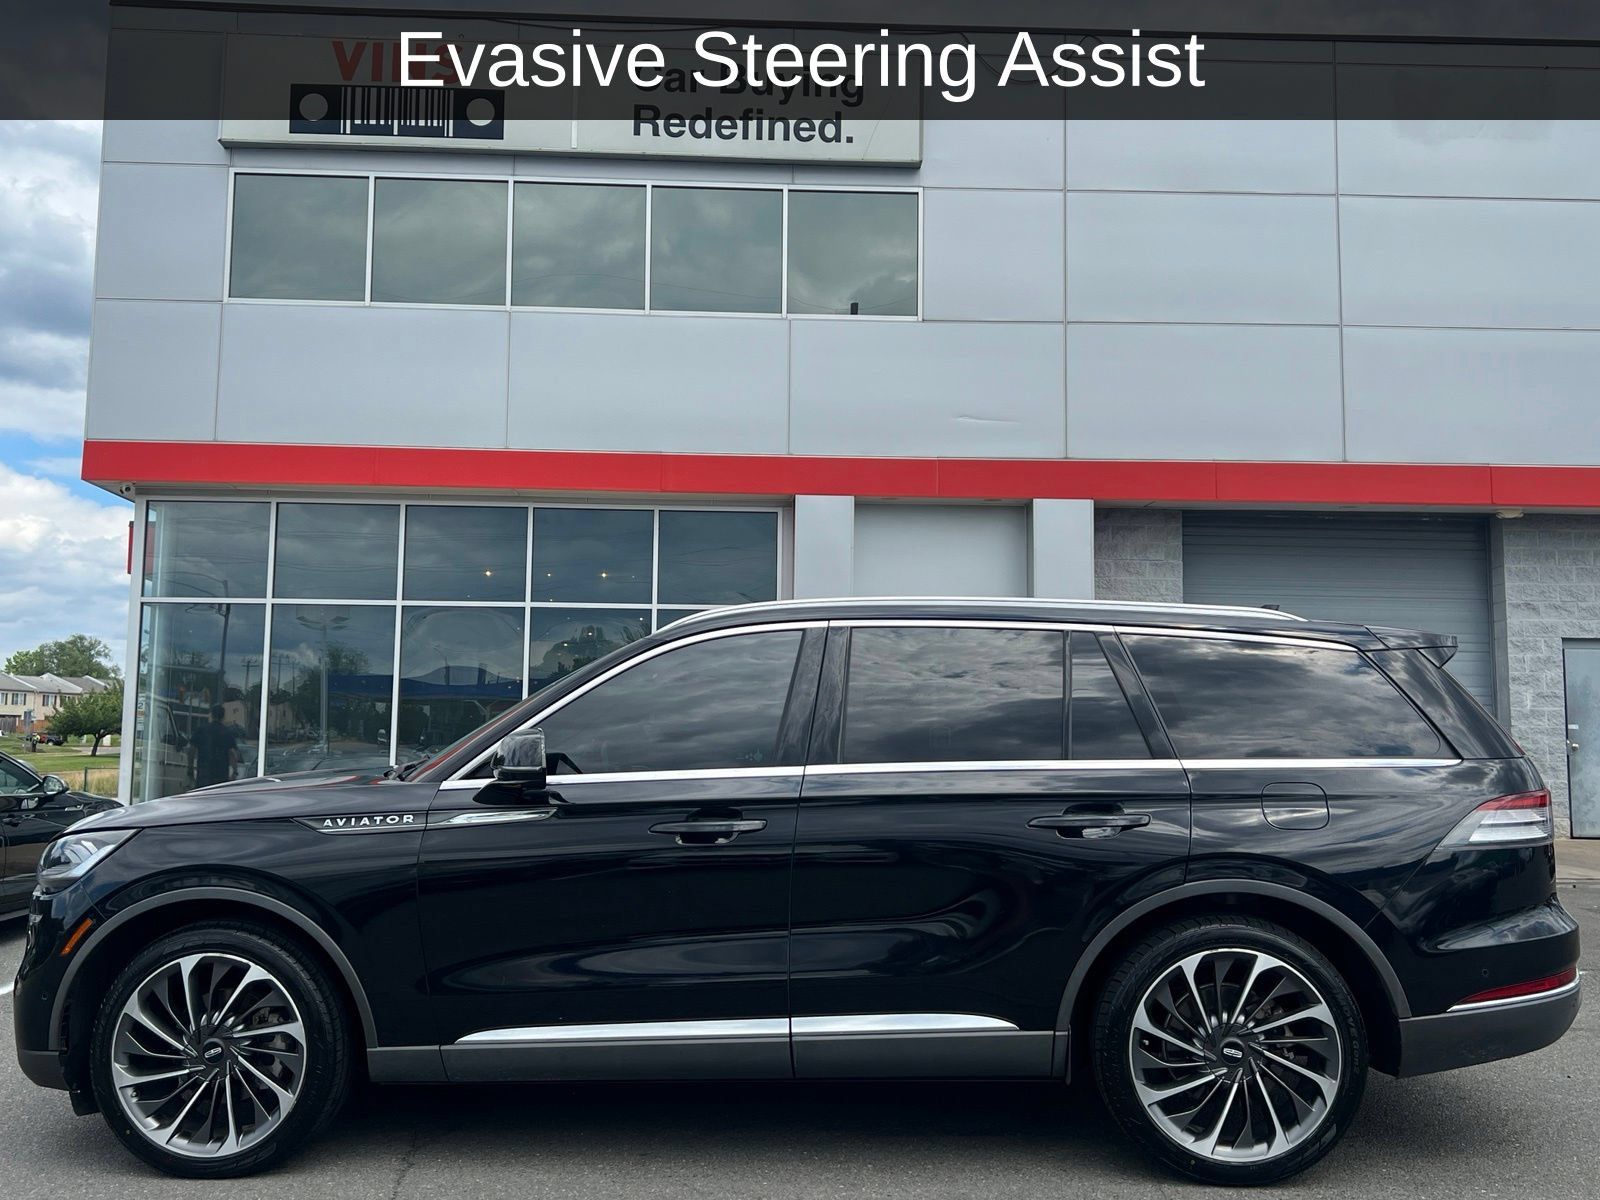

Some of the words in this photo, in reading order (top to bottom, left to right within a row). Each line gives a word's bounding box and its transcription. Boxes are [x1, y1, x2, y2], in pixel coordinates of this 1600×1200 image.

[634, 59, 705, 93] Car
[719, 62, 864, 108] Buying
[632, 103, 854, 144] Redefined.
[322, 814, 415, 828] AVIATOR
